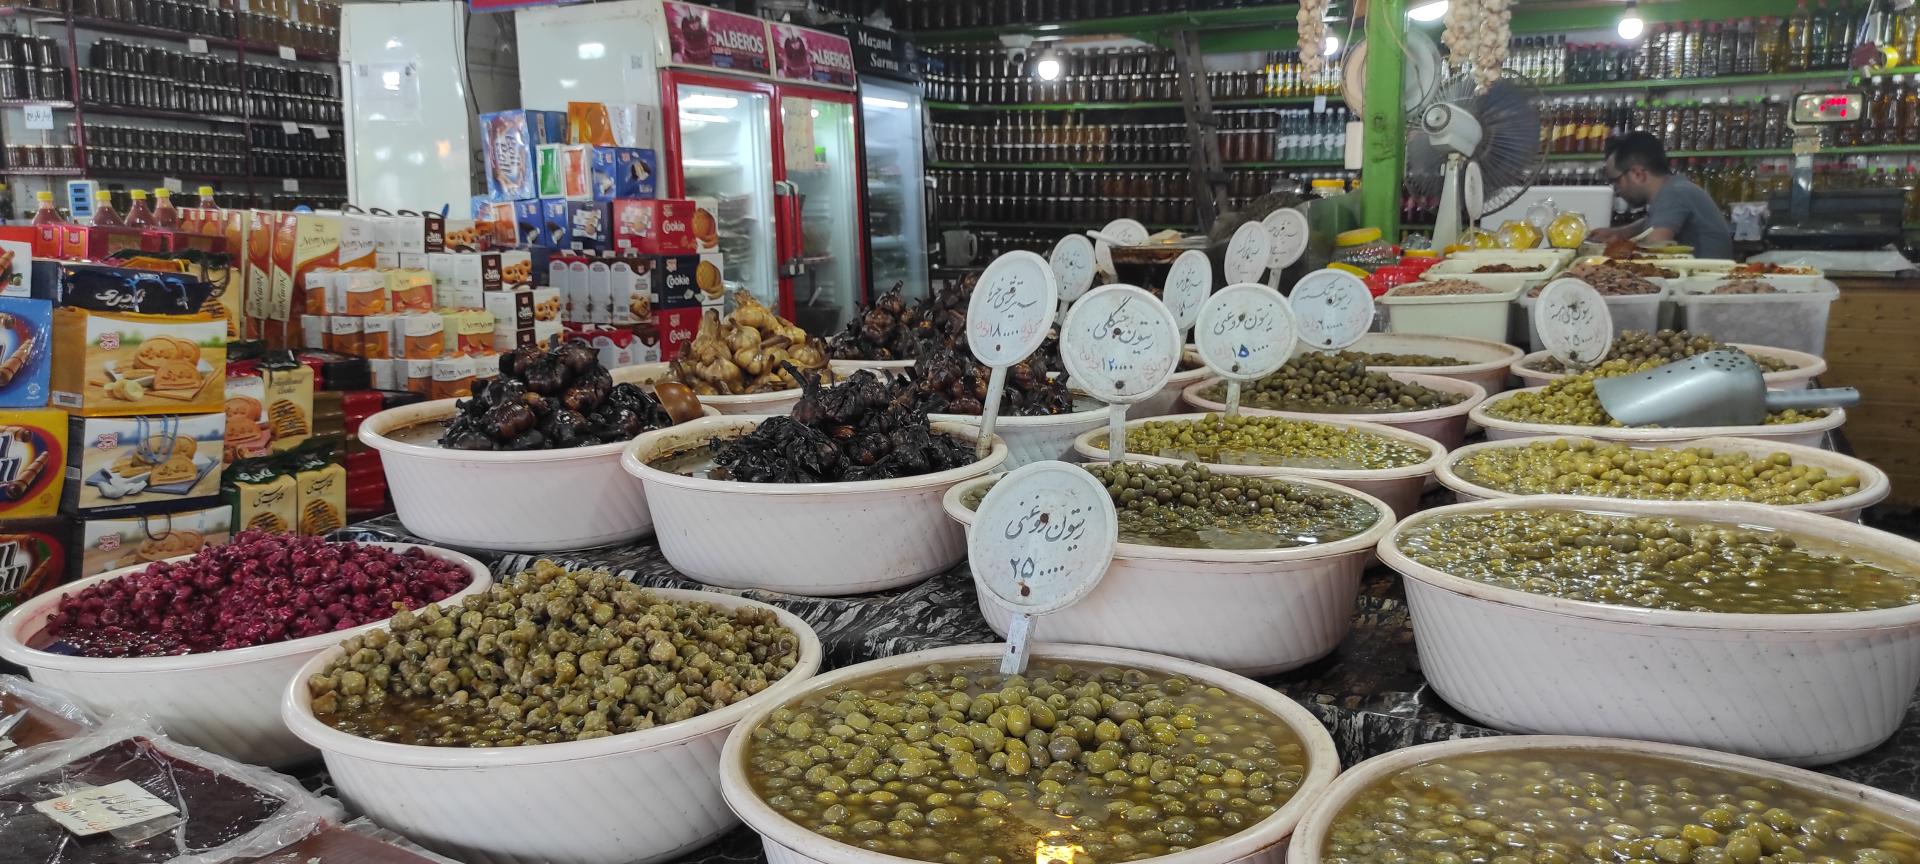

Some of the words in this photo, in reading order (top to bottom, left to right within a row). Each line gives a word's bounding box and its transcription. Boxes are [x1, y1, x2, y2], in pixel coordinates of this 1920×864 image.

[858, 31, 892, 51] Mazand
[870, 53, 899, 71] Sarma
[662, 220, 686, 234] Cookie
[666, 274, 690, 289] Cookie
[1213, 303, 1246, 335] روغنی
[1244, 303, 1273, 333] زیتون
[669, 329, 692, 343] Cookie
[1119, 320, 1160, 355] زیتون
[1231, 344, 1269, 359] ۱۵۰۰۰۰
[1005, 495, 1048, 540] روغنی
[1045, 506, 1092, 552] زیتون
[1009, 557, 1065, 580] ۲۵۰۰۰۰
